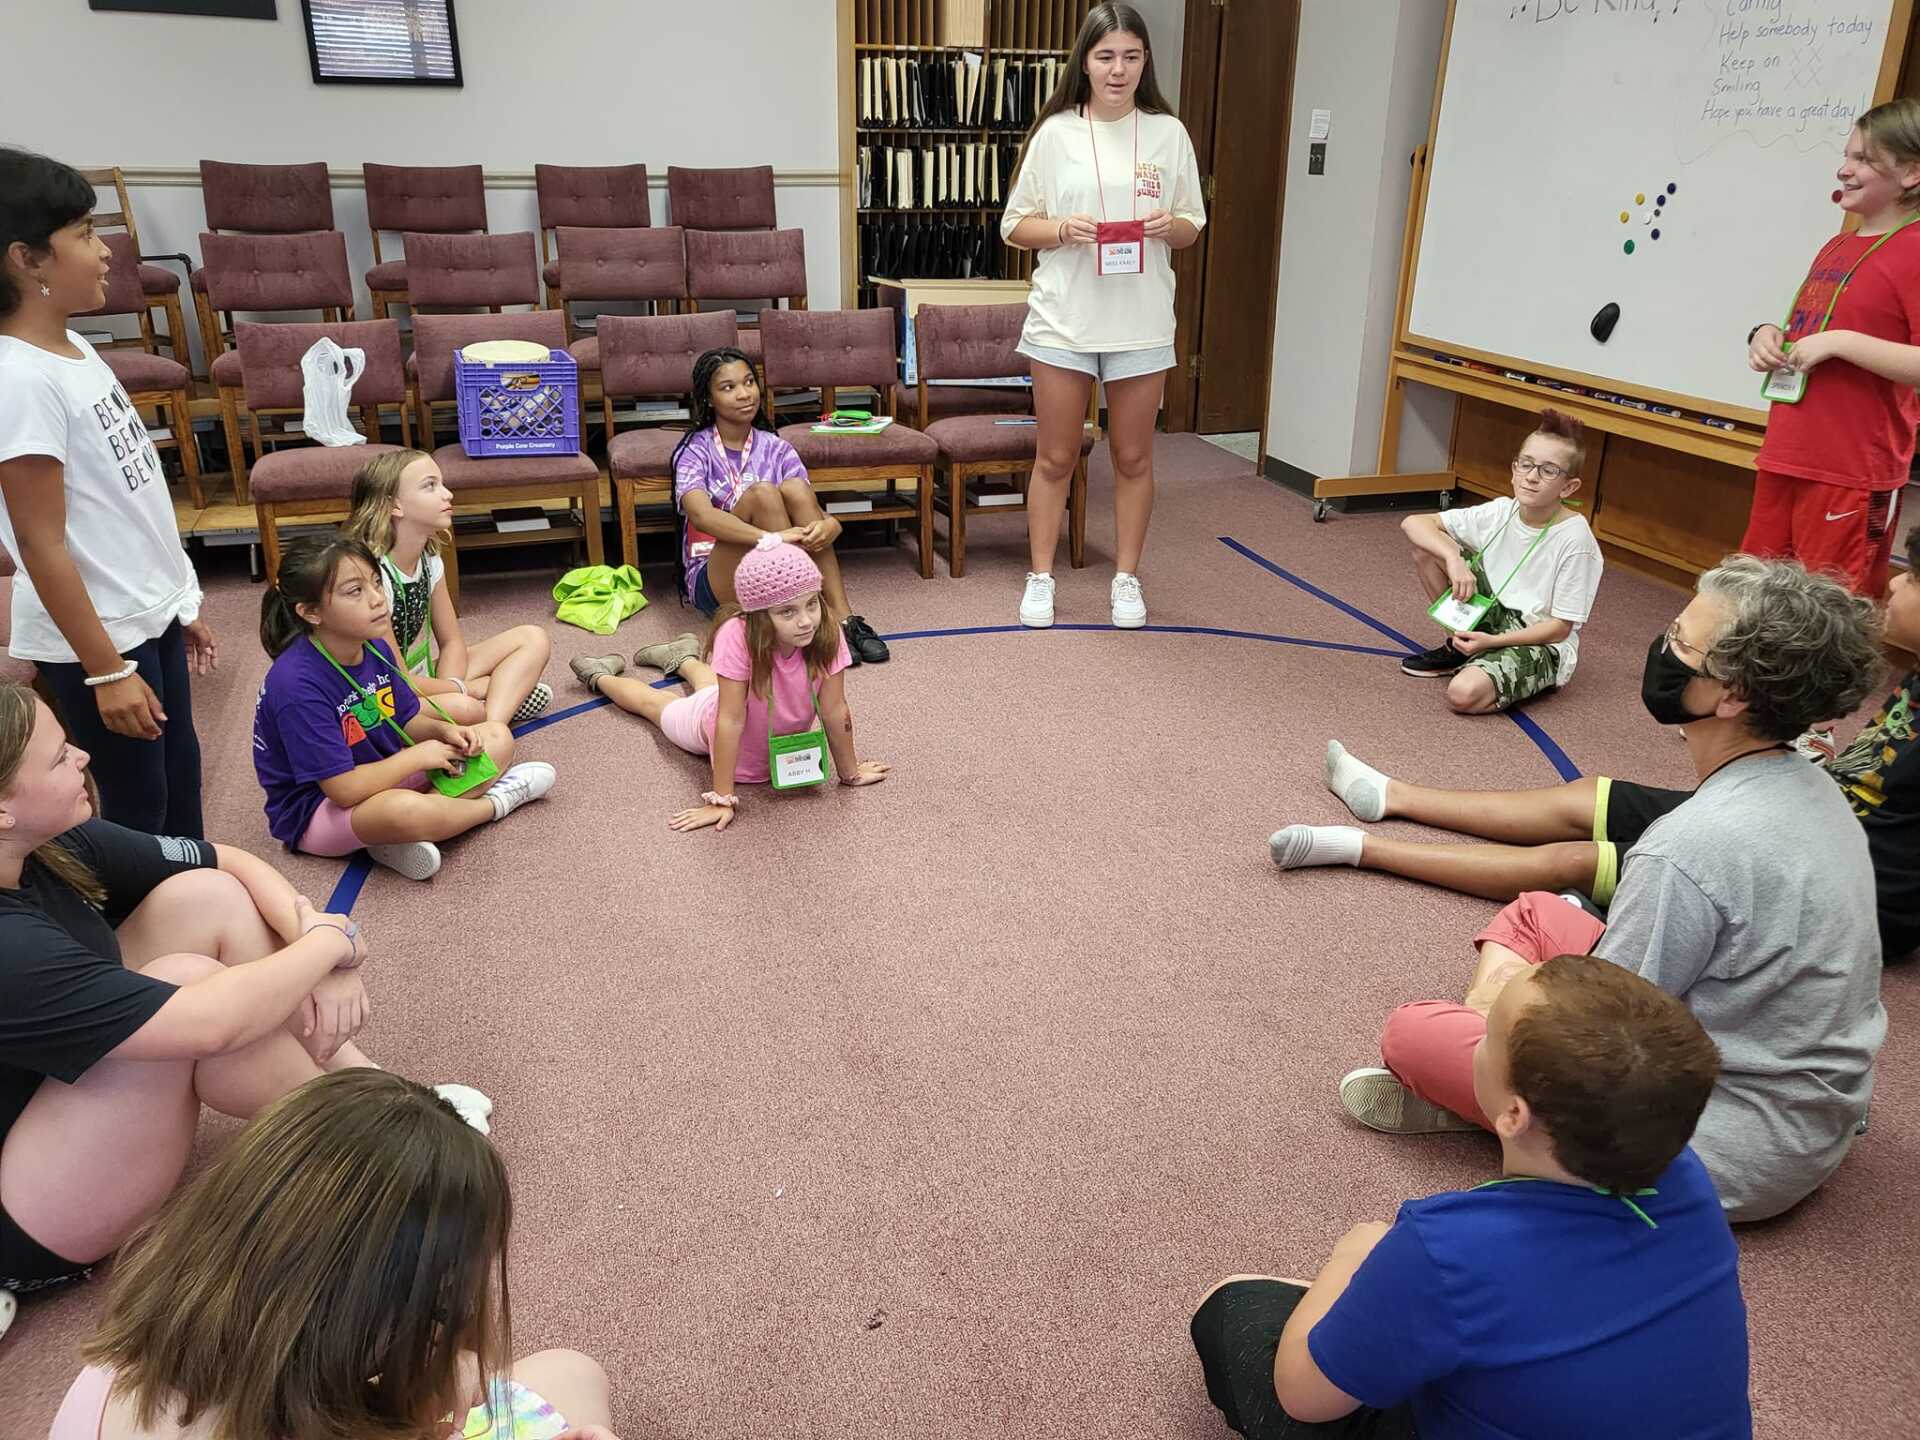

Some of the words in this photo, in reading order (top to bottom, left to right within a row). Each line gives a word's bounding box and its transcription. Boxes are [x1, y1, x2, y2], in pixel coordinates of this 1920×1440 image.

[1719, 20, 1750, 50] Help
[1755, 14, 1819, 46] somebody
[1827, 14, 1873, 45] today
[1719, 53, 1755, 73] Keep
[1764, 55, 1781, 67] on
[1712, 74, 1761, 106] Smiling
[1701, 99, 1730, 125] Hope
[1734, 107, 1753, 126] you
[1755, 100, 1783, 118] have
[1786, 105, 1796, 118] a
[1796, 96, 1829, 133] great
[93, 397, 121, 431] BE
[108, 427, 136, 462] BE
[121, 457, 151, 492] BE
